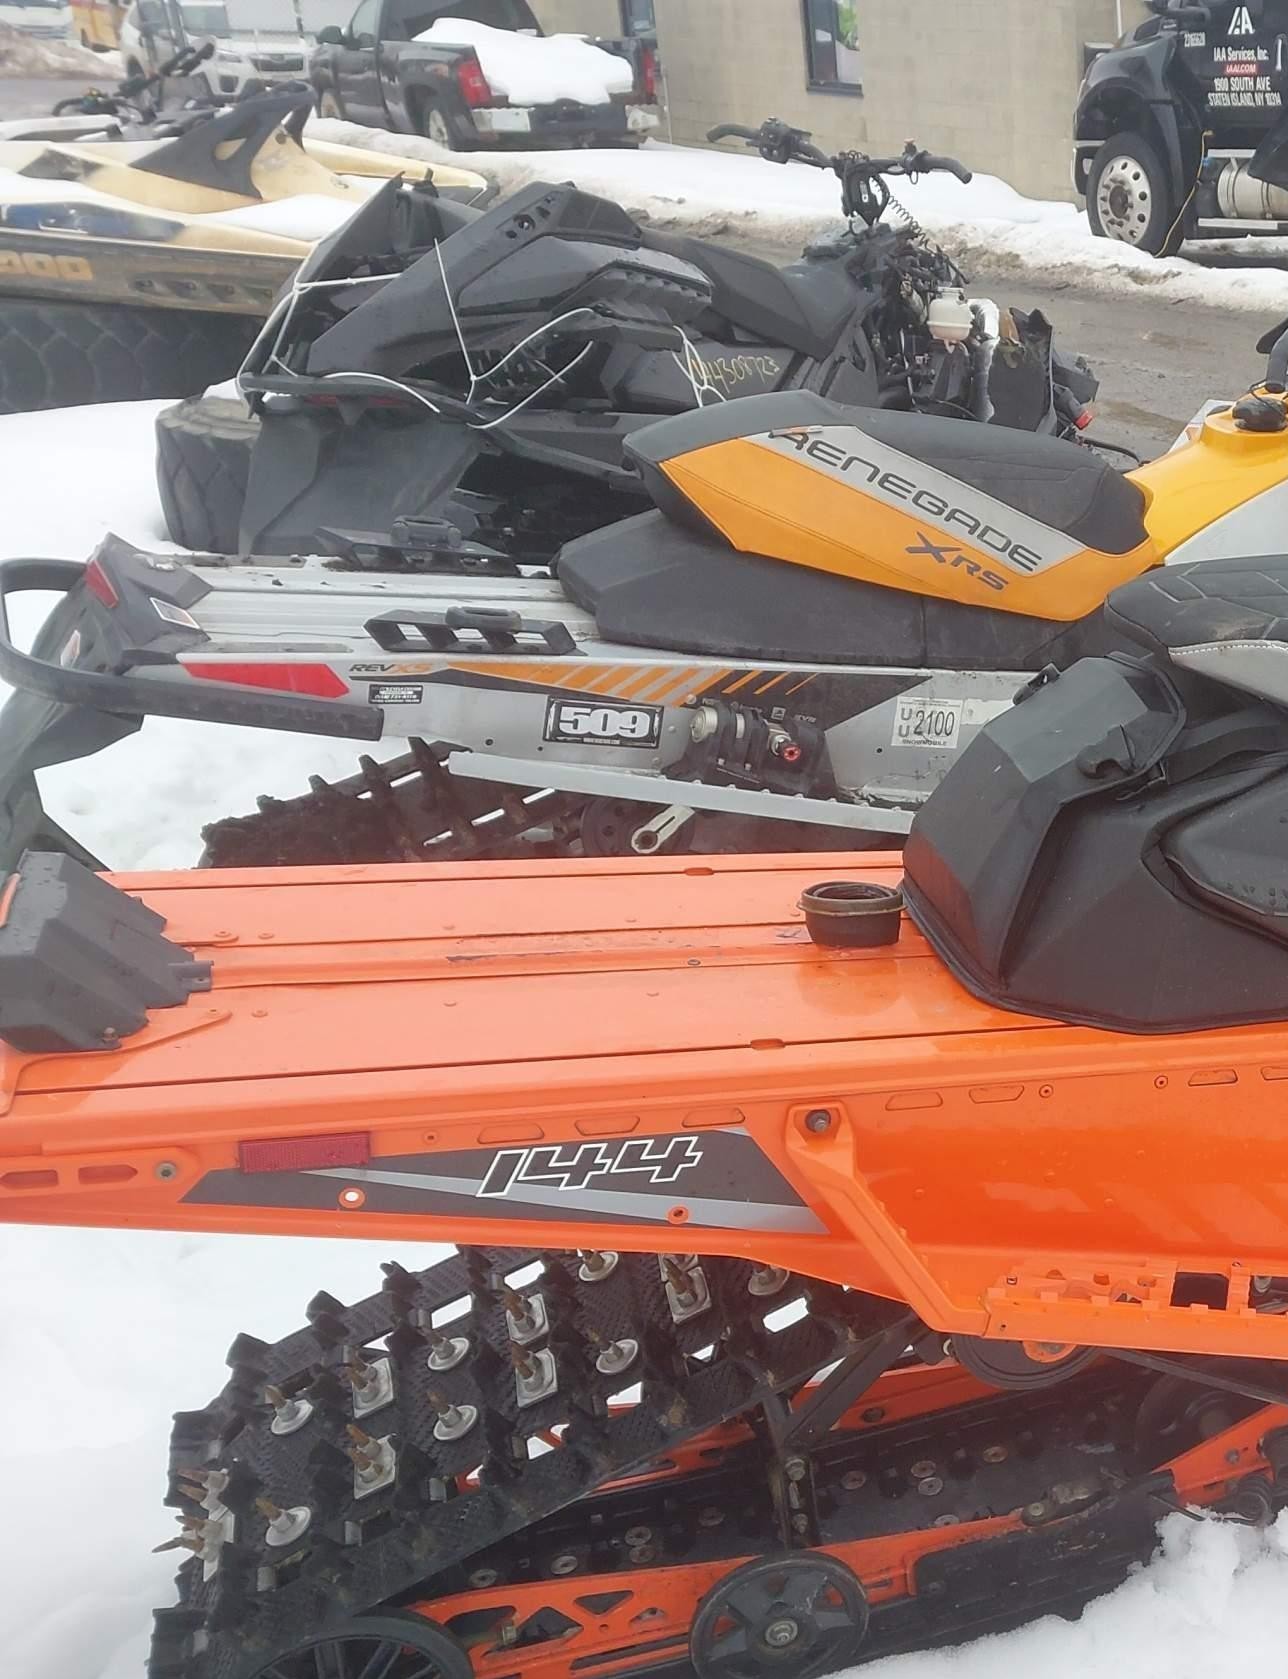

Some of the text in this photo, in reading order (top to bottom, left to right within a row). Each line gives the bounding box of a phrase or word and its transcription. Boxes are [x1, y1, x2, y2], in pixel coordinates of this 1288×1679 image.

[1213, 45, 1269, 62] IAA Services, Inc.
[1214, 76, 1271, 91] 1900 SOUTH AVE
[1208, 92, 1230, 106] STATEN
[1255, 92, 1264, 106] NY
[905, 531, 1009, 591] XRS
[558, 706, 651, 738] 509
[898, 725, 909, 738] U
[901, 708, 955, 737] U 2100
[476, 1136, 703, 1197] 144
